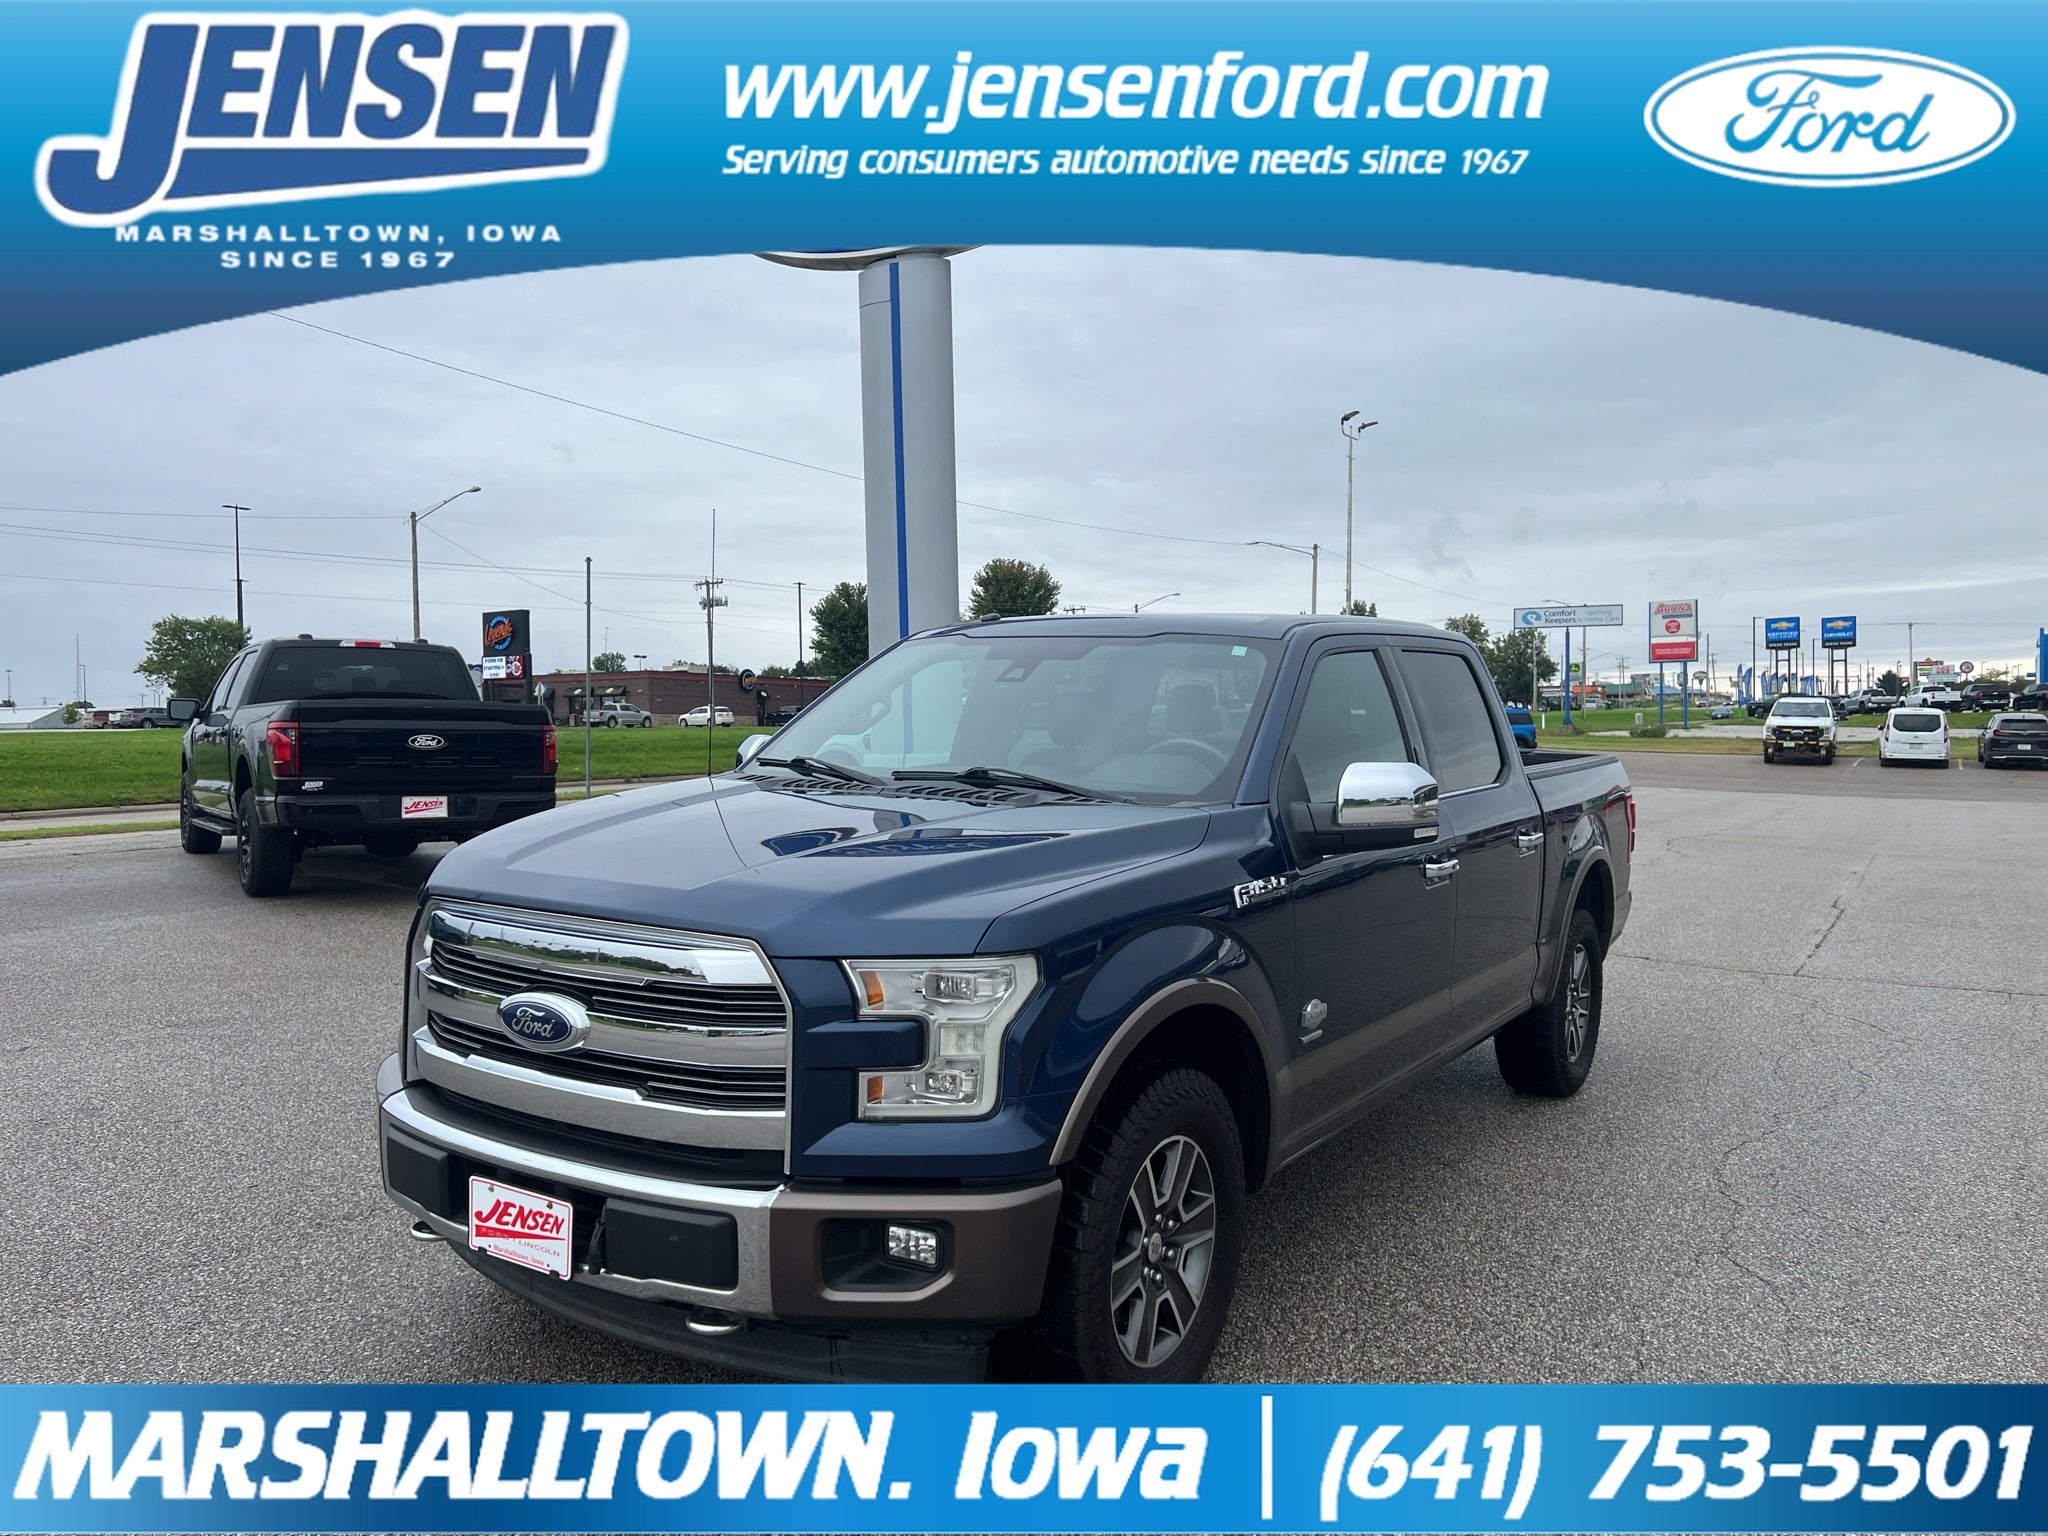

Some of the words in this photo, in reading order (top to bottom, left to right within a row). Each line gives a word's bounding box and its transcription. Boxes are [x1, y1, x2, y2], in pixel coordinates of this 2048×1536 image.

[414, 736, 438, 746] Ford
[404, 800, 445, 811] JENSEN
[511, 1006, 556, 1038] Ford
[474, 1198, 565, 1235] JENSEN
[519, 1240, 560, 1258] LINCOLN
